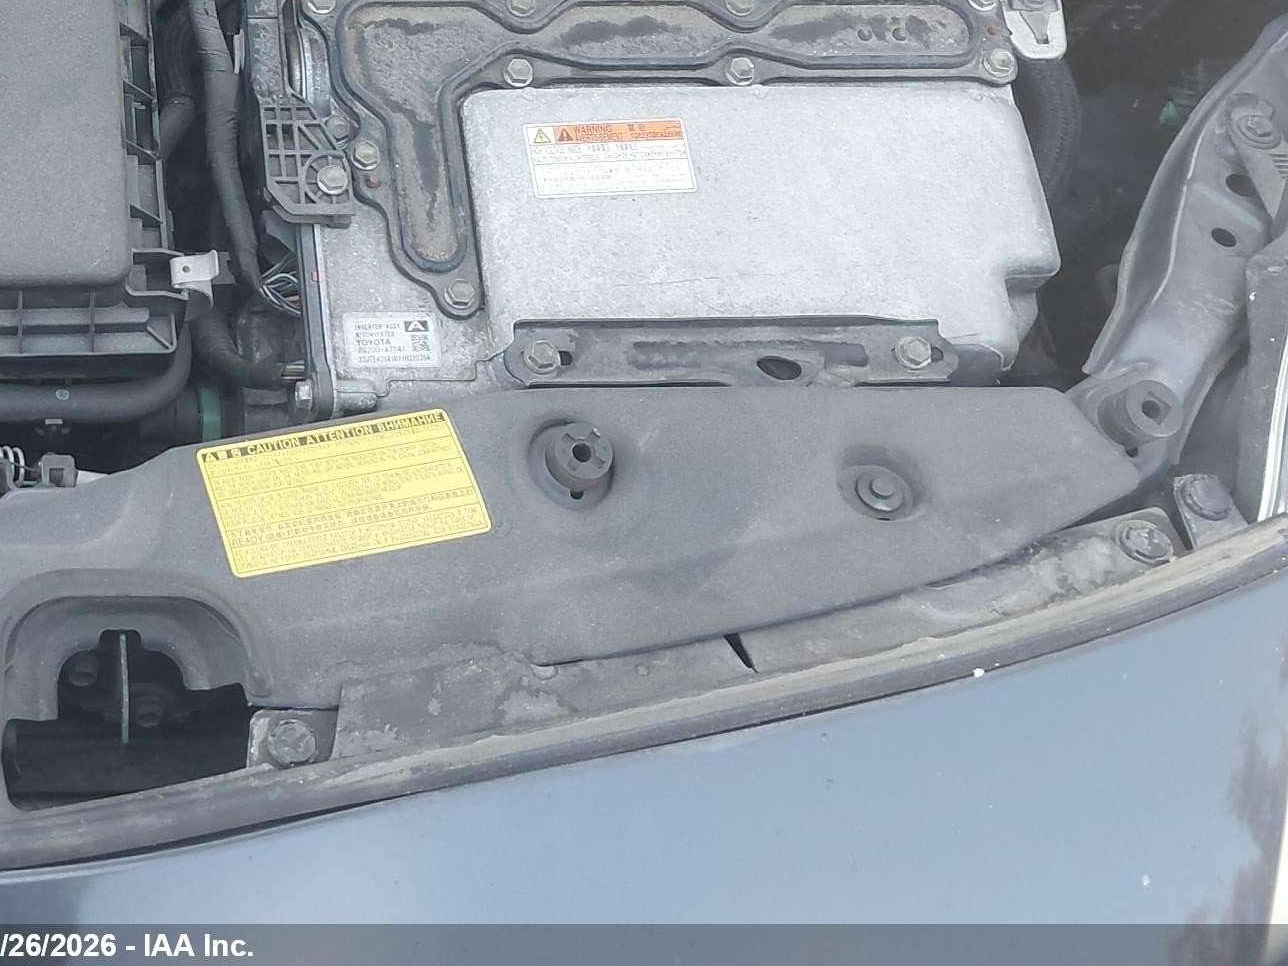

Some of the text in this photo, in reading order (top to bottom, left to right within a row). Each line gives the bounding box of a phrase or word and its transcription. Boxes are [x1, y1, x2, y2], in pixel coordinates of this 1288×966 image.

[574, 124, 612, 134] WARNING
[357, 338, 392, 346] TOYOTA
[247, 437, 301, 455] CAUTION
[306, 423, 373, 445] ATTENTION
[378, 412, 443, 432] ВНИМАНИЕ
